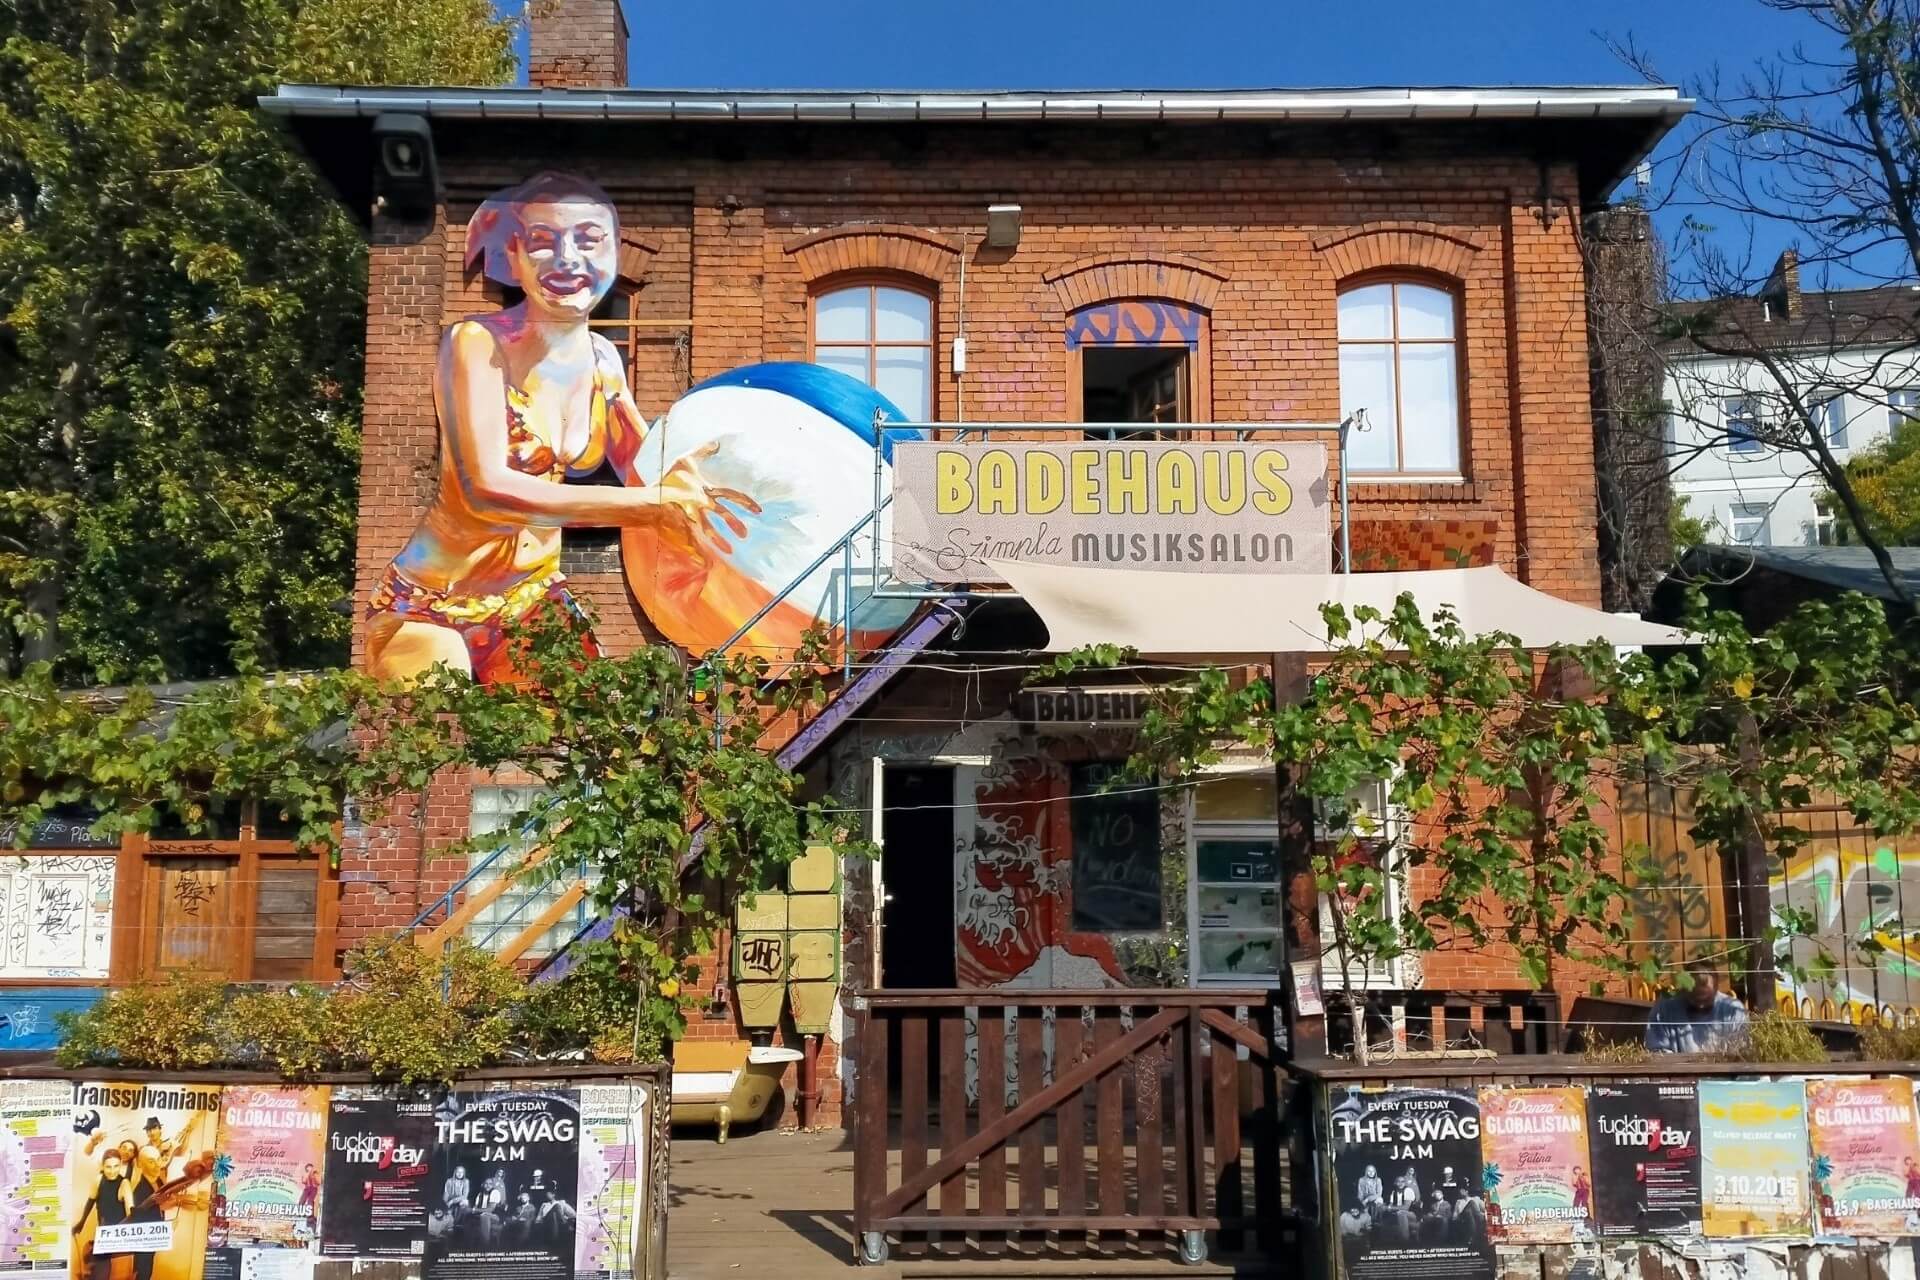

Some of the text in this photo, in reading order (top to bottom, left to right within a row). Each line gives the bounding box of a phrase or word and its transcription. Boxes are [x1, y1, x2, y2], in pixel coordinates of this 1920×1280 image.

[935, 450, 1294, 516] BADEHAUS
[936, 521, 1295, 572] Szimpla MUSIKSALON
[1037, 693, 1147, 721] BADEH
[72, 1081, 219, 1112] Transsylvanians
[248, 1091, 298, 1108] Danza
[1835, 1089, 1884, 1106] Danza
[465, 1101, 548, 1113] EVERY TUESDAY
[1367, 1100, 1450, 1112] EVERY TUESDAY
[1506, 1098, 1556, 1114] Danza
[226, 1107, 322, 1129] GLOBALISTAN
[1486, 1115, 1581, 1135] GLOBALISTAN
[1815, 1105, 1911, 1127] GLOBALISTAN
[434, 1119, 575, 1144] THE SWAG
[1339, 1117, 1480, 1143] THE SWAG
[481, 1146, 525, 1162] JAM
[1390, 1144, 1434, 1160] JAM
[1714, 1175, 1797, 1196] 3.10.2015
[257, 1201, 313, 1216] BADEHAUS
[1534, 1206, 1588, 1219] BADEHAUS
[101, 1225, 168, 1238] Fr 16.10. 20h
